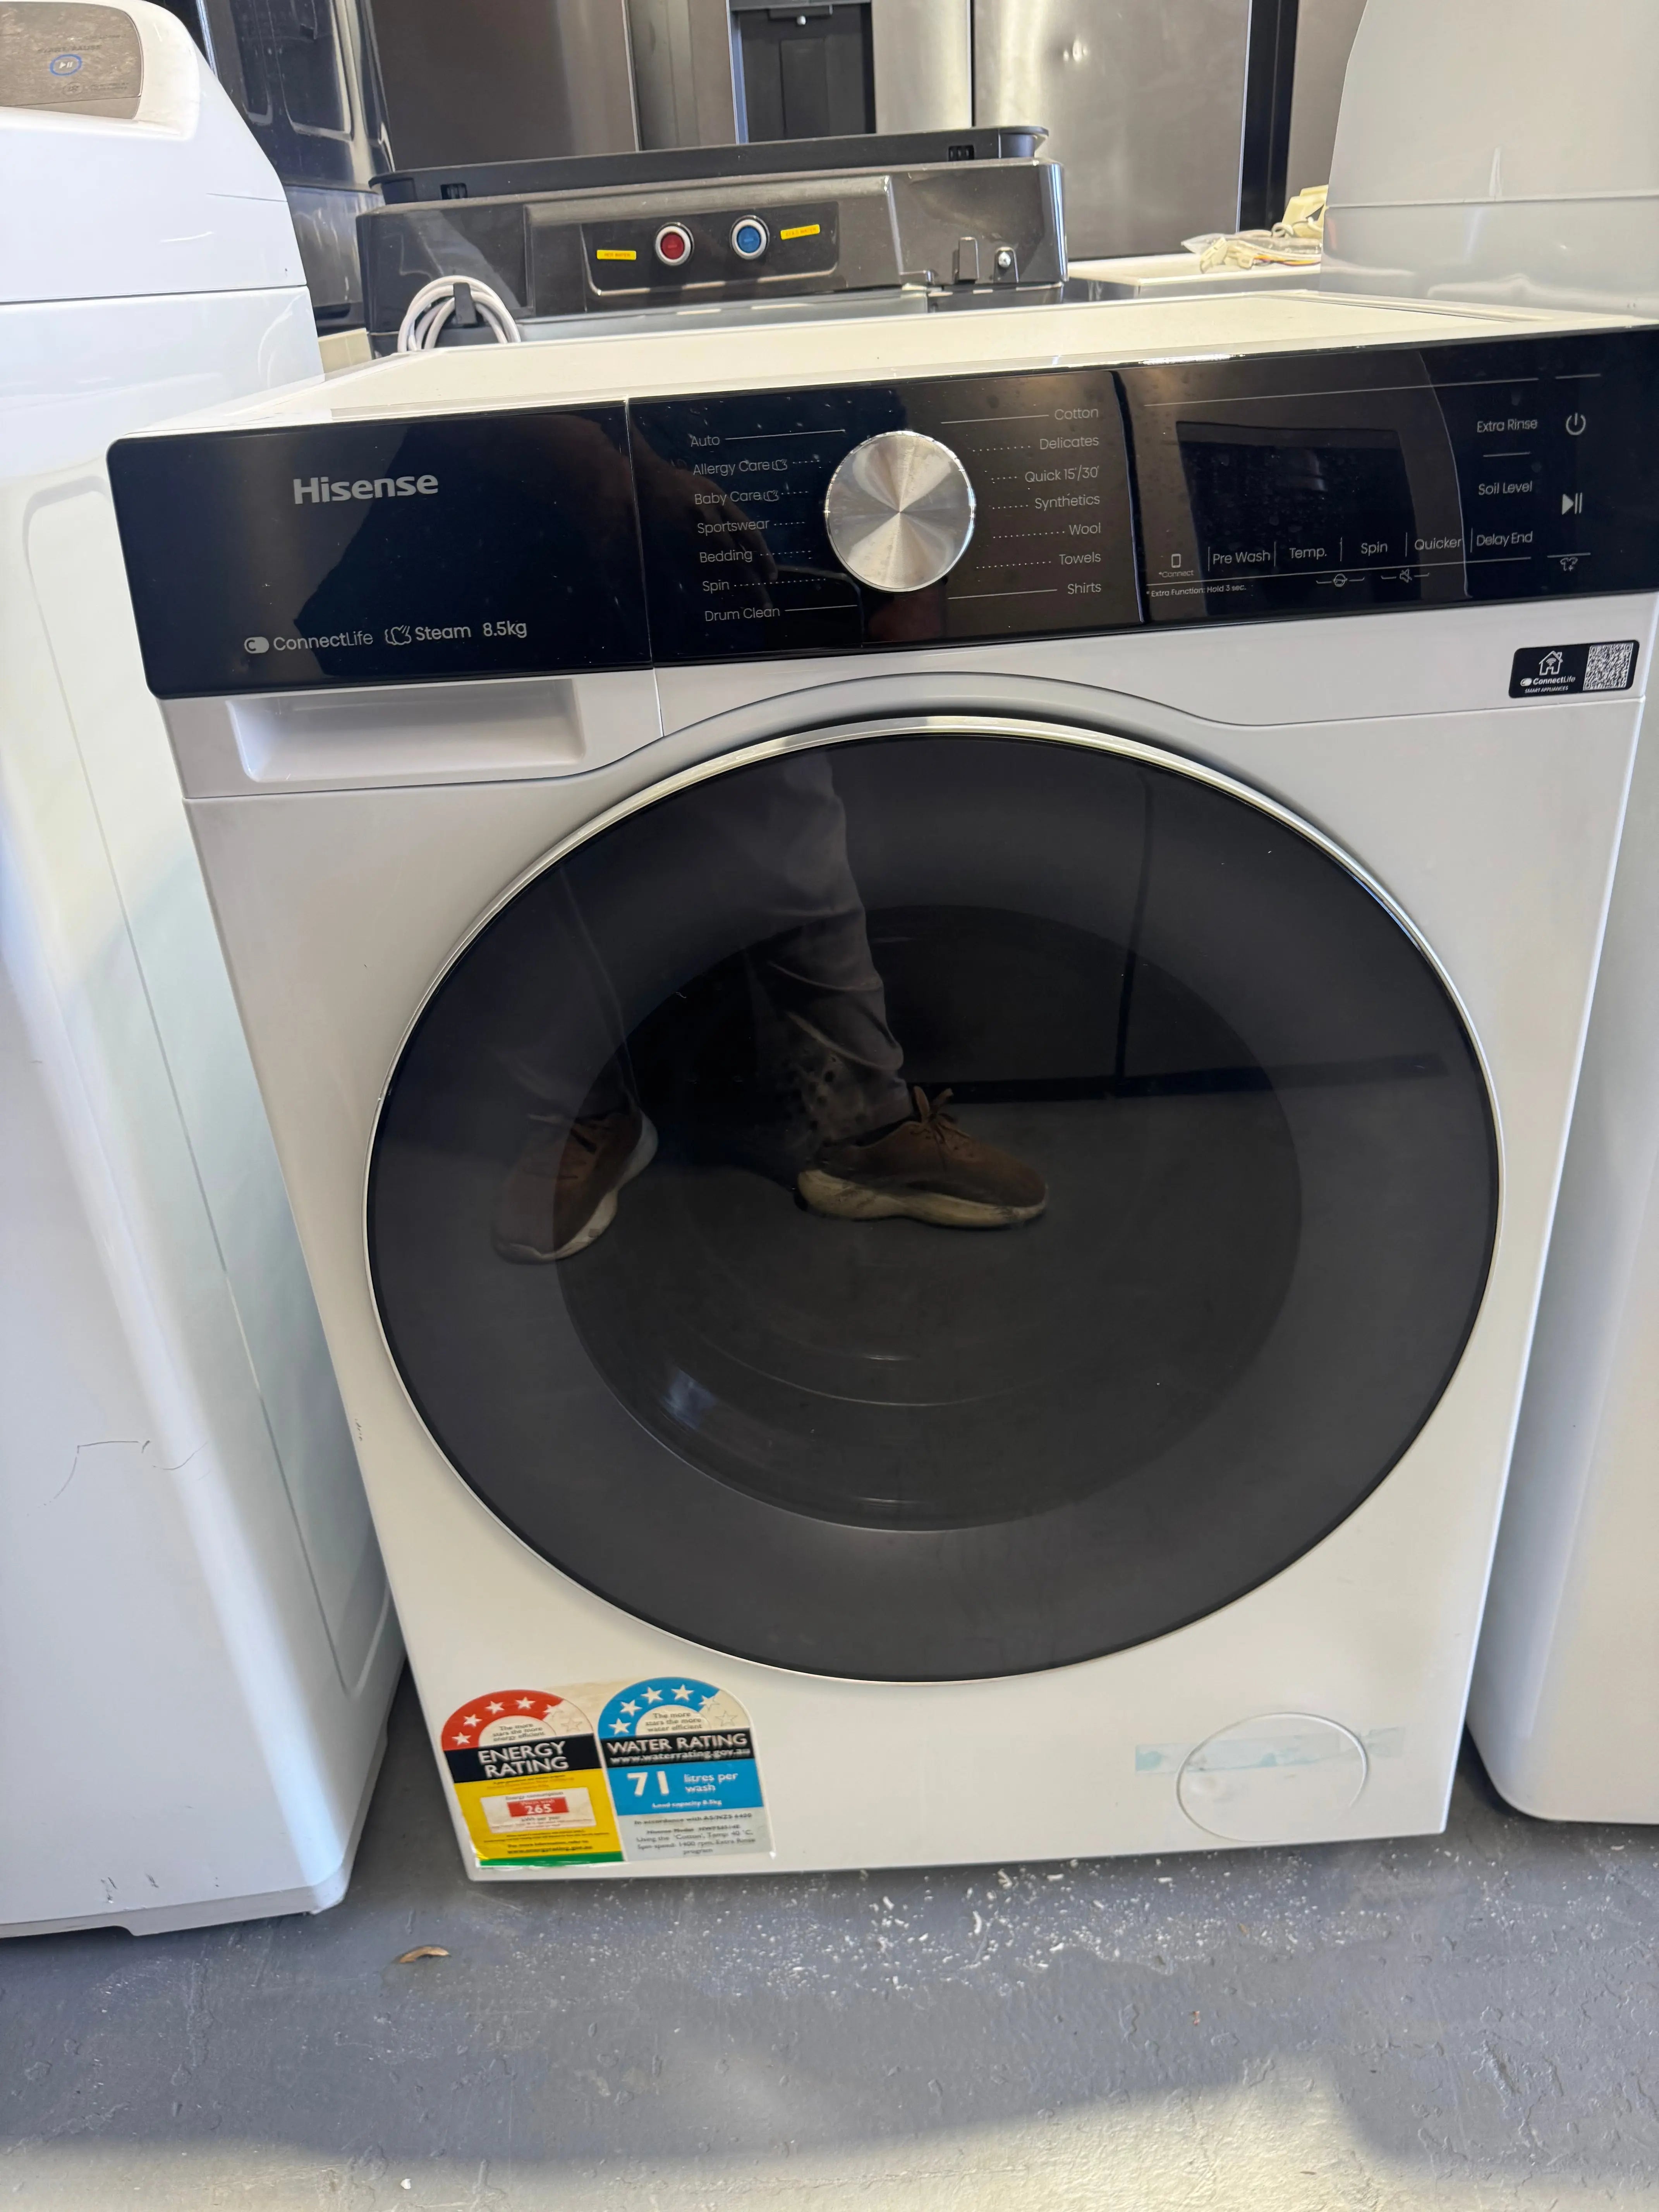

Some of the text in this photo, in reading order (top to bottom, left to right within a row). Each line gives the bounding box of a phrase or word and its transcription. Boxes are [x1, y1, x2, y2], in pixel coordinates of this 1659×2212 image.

[1054, 409, 1099, 421] Cotton
[1477, 419, 1538, 433] Extra Rinse
[690, 436, 720, 447] Auto
[1040, 436, 1099, 450] Delicates
[693, 461, 770, 476] Allergy Care
[1025, 469, 1061, 483] Quick
[293, 474, 439, 505] Hisense
[1479, 481, 1532, 495] Soil Level
[695, 491, 761, 505] Baby Care
[1035, 494, 1100, 511] Synthetics
[697, 520, 770, 536] Sportswear
[1069, 522, 1101, 535] Wool
[1415, 538, 1462, 551] Quicker
[1476, 531, 1533, 547] Delay End
[1289, 547, 1327, 559] Temp.
[1361, 542, 1388, 555] Spin
[700, 550, 753, 563] Bedding
[1059, 551, 1101, 565] Towels
[1213, 550, 1270, 565] Pre Wash
[703, 580, 729, 593] Spin
[1068, 582, 1101, 595] Shirts
[1171, 587, 1205, 596] Function:
[705, 607, 780, 622] Drum Clean
[274, 621, 527, 652] ConnectLife Steam 8.5kg
[1533, 675, 1575, 685] ConnectLife
[607, 1733, 747, 1754] WATER RATING
[478, 1741, 566, 1765] ENERGY
[610, 1748, 750, 1765] www.waterrating.gov.au
[484, 1756, 569, 1779] RATING
[627, 1771, 670, 1796] 71
[684, 1772, 738, 1783] litres per
[685, 1783, 716, 1793] wash
[526, 1803, 553, 1814] 265
